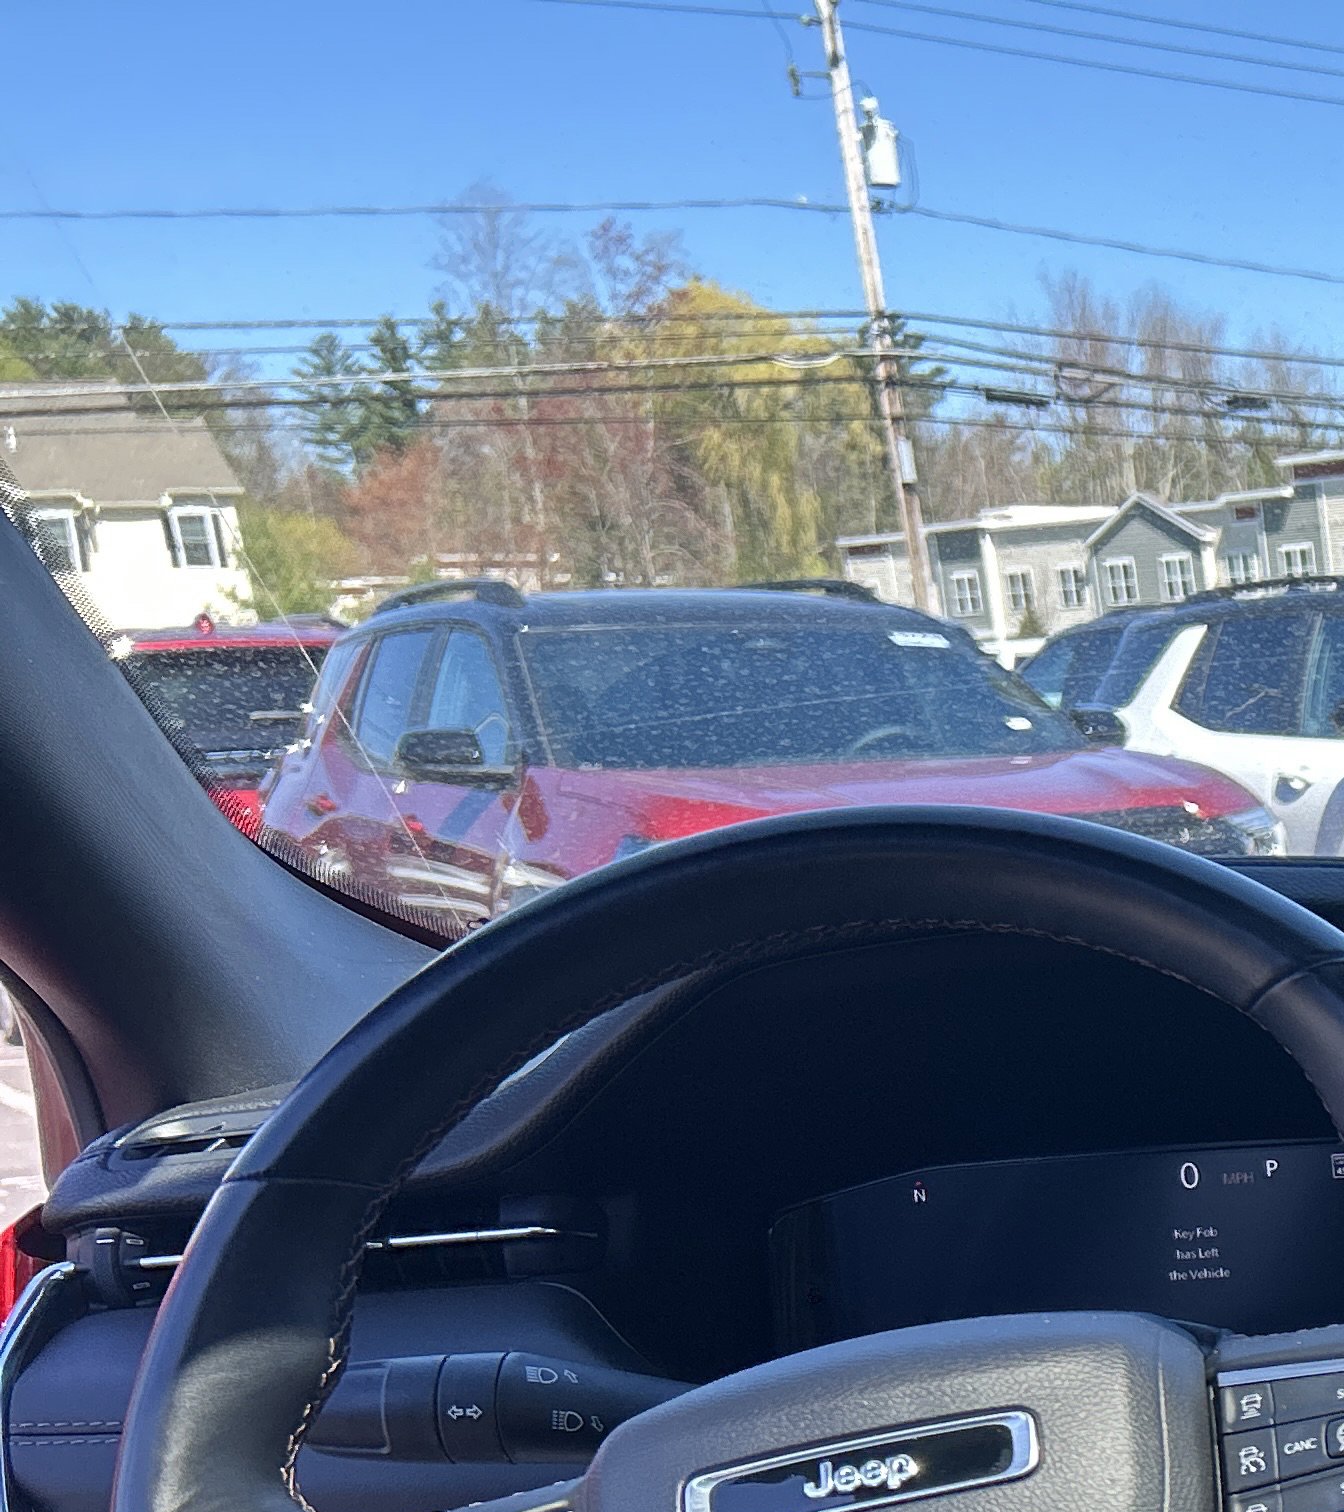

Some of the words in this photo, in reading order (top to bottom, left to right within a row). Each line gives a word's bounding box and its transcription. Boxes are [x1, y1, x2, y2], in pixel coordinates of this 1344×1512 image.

[1265, 1159, 1279, 1177] P
[1222, 1172, 1254, 1185] MPH
[913, 1187, 926, 1203] N
[1173, 1229, 1194, 1242] Key
[1196, 1226, 1218, 1239] Fob
[1176, 1249, 1197, 1260] has
[1198, 1248, 1220, 1259] Left
[1168, 1270, 1188, 1281] the
[1189, 1267, 1231, 1281] Vehicle
[1284, 1437, 1318, 1455] CANC
[803, 1453, 920, 1499] Jeep
